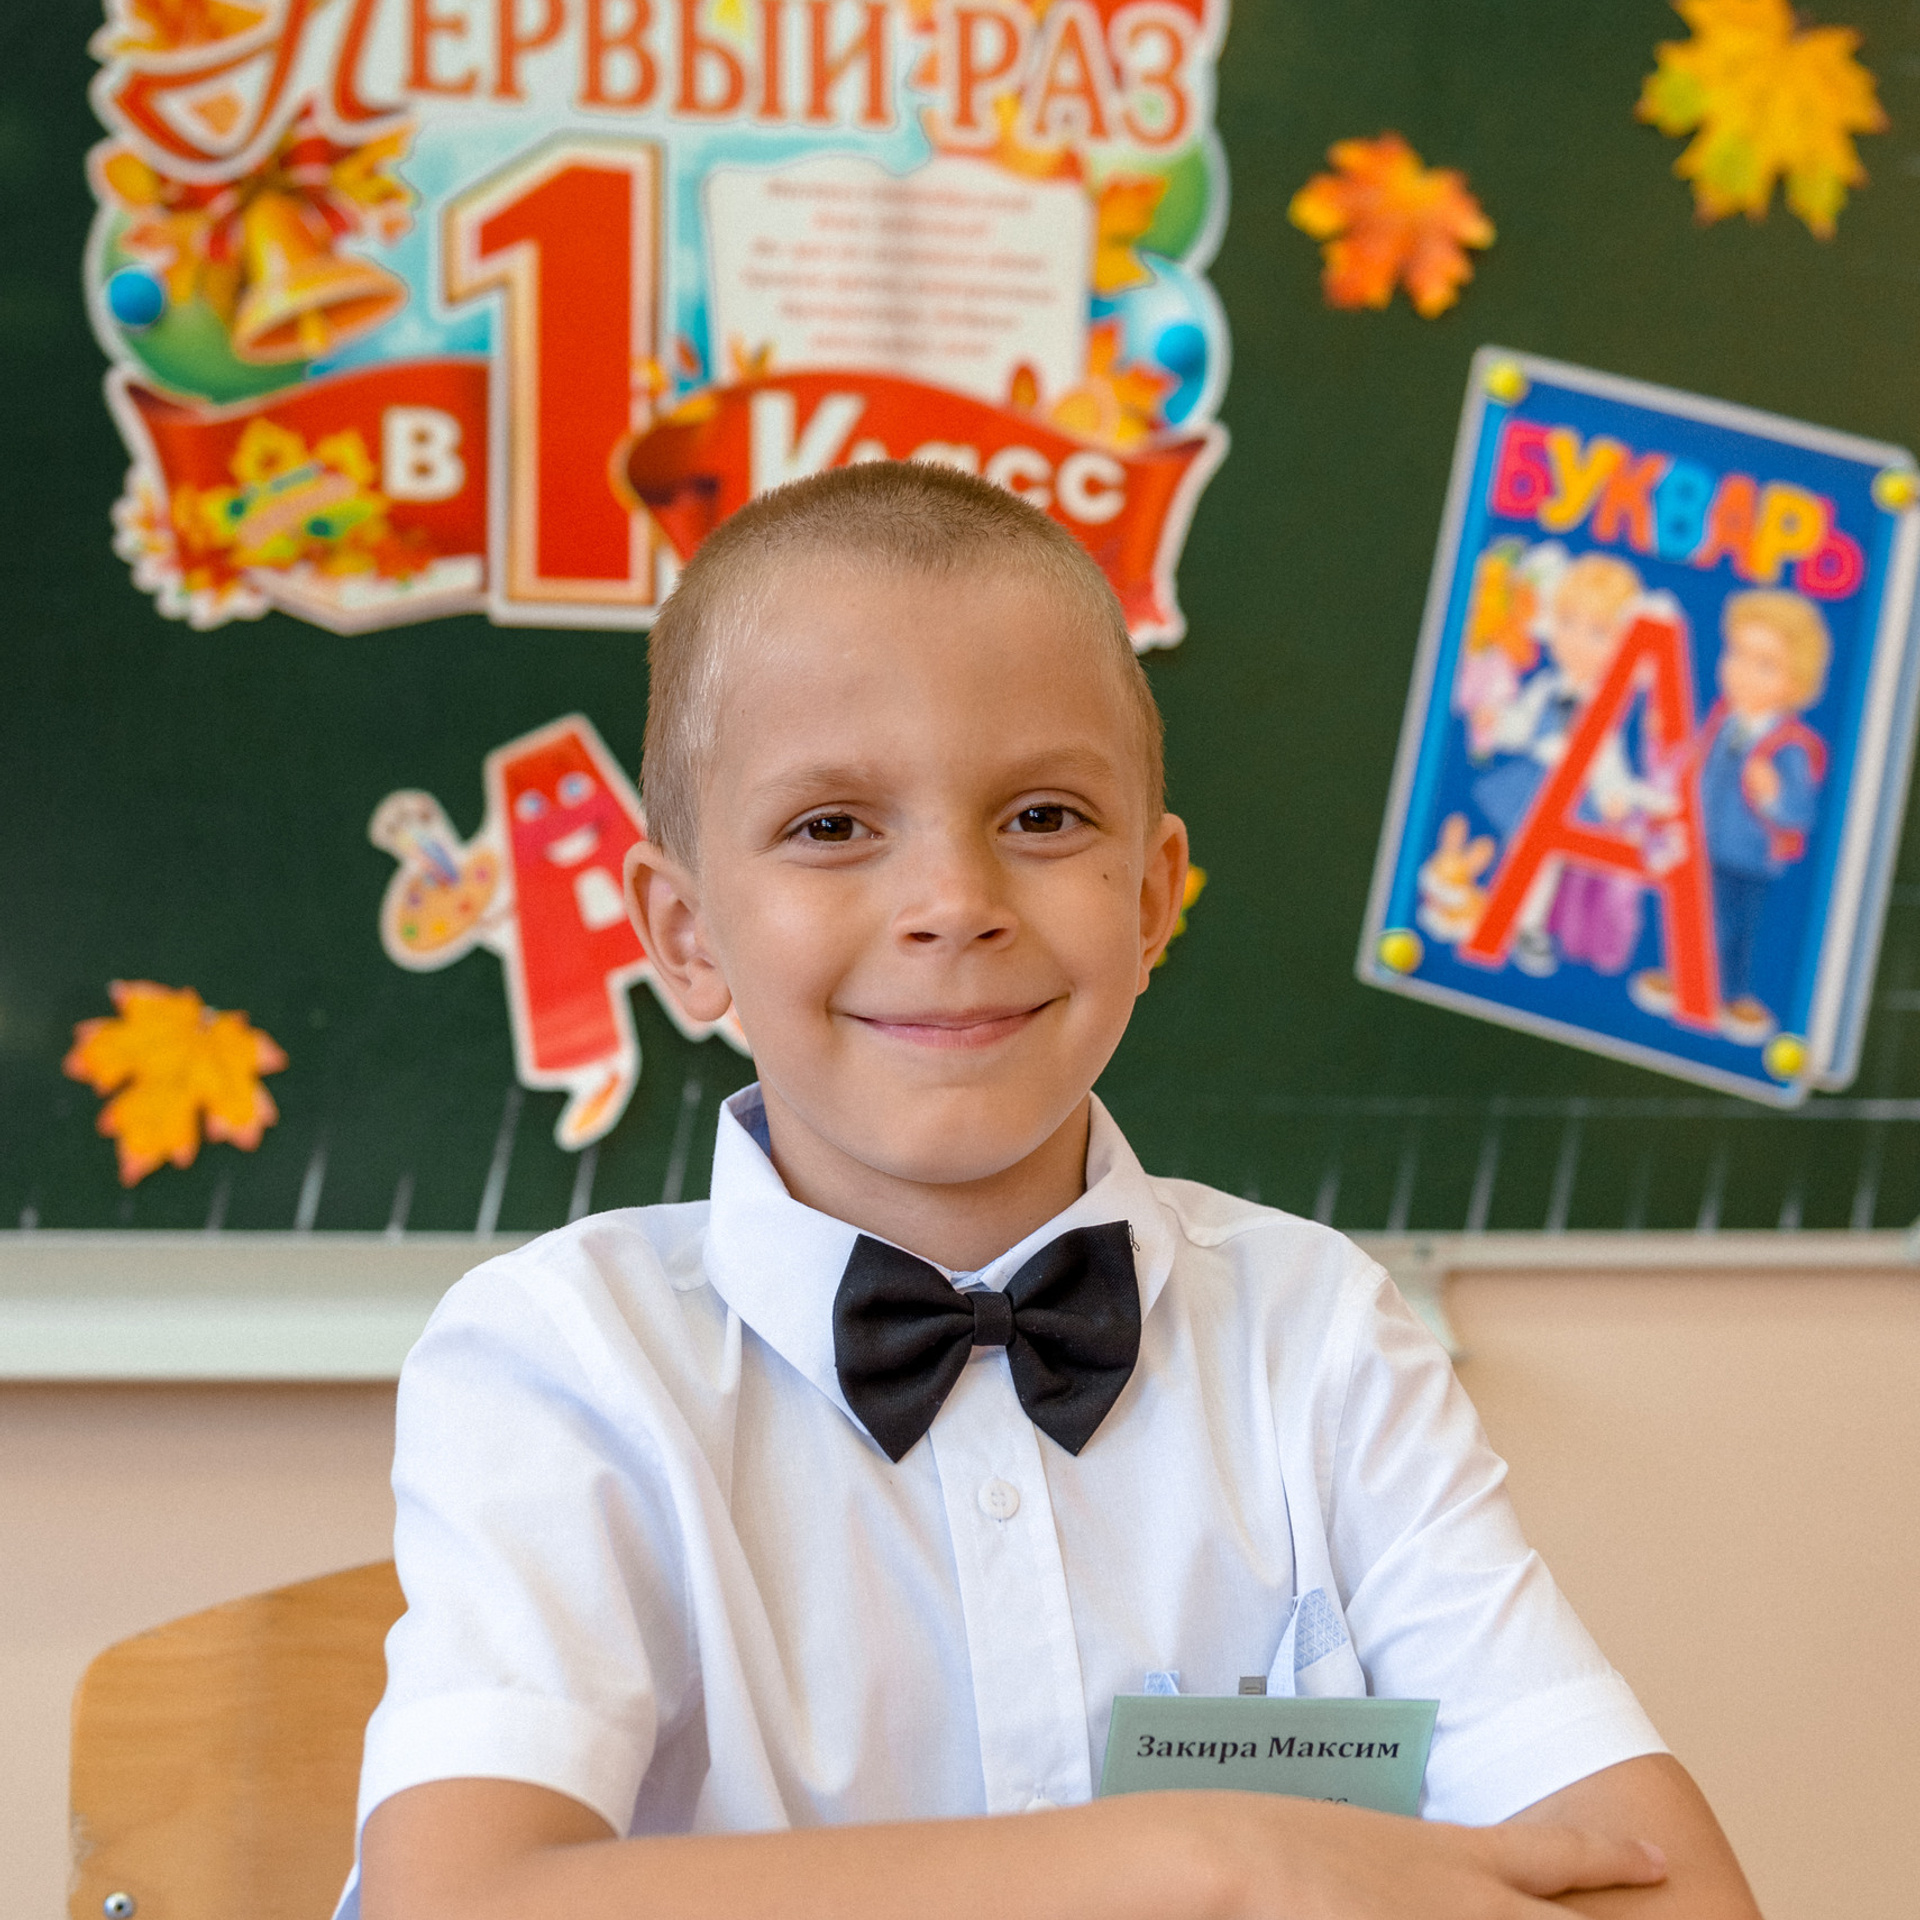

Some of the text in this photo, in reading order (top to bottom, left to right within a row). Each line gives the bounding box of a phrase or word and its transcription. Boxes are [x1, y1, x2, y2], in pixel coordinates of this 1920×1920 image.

[954, 10, 1191, 147] РАЗ
[472, 155, 640, 590] 1
[1488, 419, 1864, 599] БУКВАРЬ
[1136, 1734, 1401, 1765] Закира Максим
